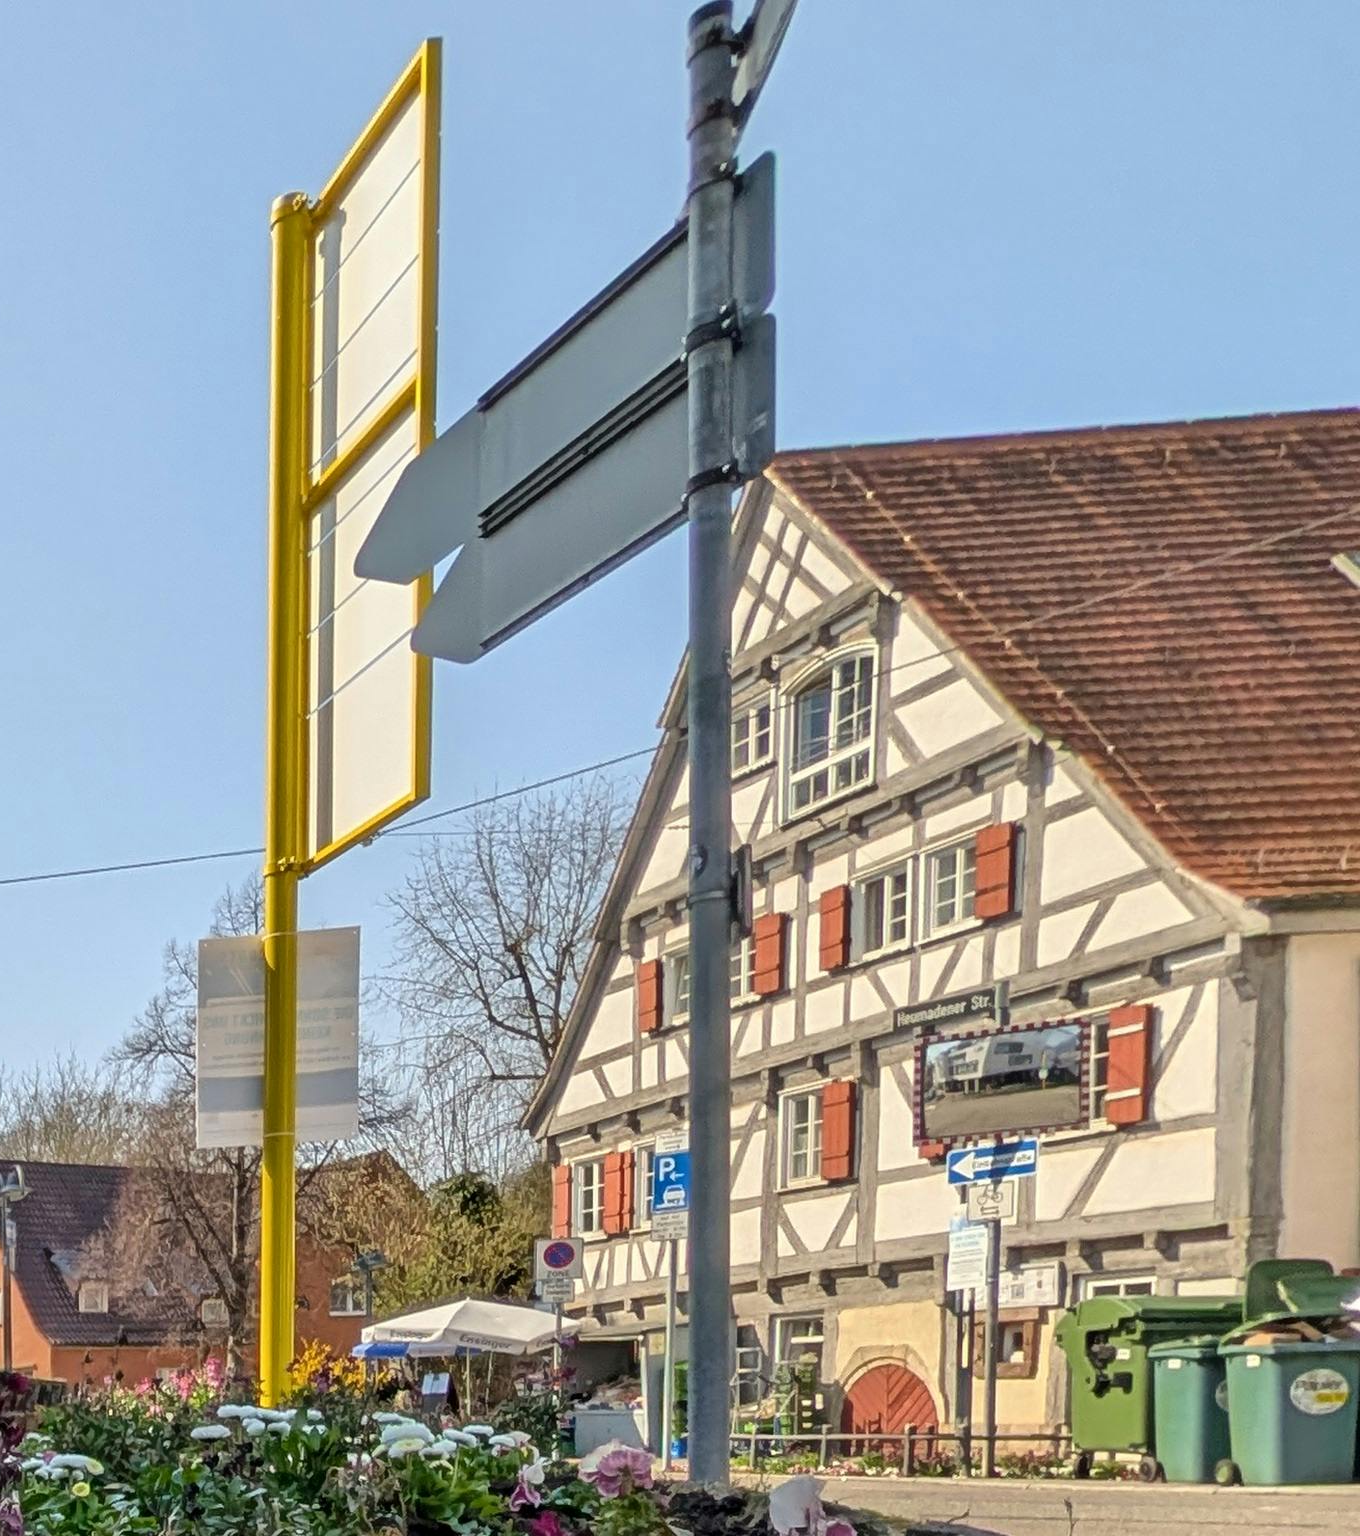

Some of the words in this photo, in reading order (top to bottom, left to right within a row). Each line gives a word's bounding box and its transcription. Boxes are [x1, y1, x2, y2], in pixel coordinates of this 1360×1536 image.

[970, 994, 994, 1011] Str.
[659, 1157, 676, 1182] P
[459, 1333, 513, 1350] Ensinger
